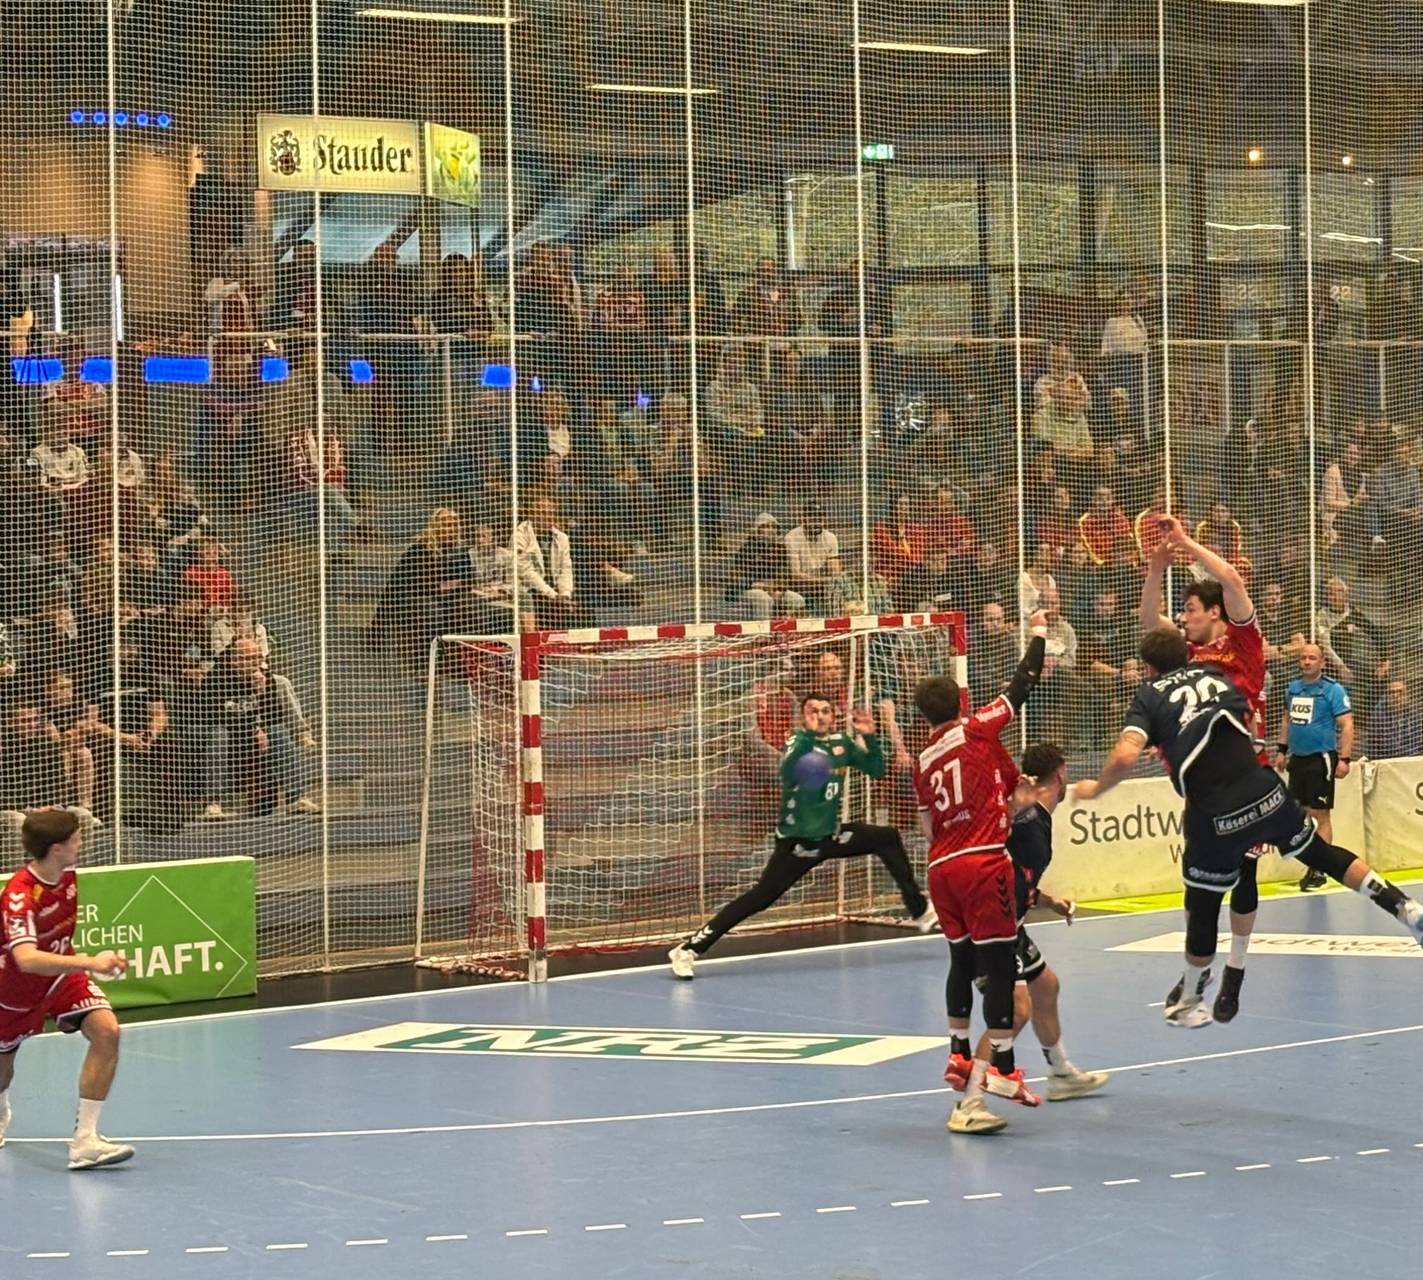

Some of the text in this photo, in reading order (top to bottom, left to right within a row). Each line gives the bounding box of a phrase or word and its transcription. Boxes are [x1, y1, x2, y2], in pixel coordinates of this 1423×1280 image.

[313, 135, 411, 175] Stauder
[930, 758, 963, 811] 37
[410, 1028, 840, 1060] NRZ
